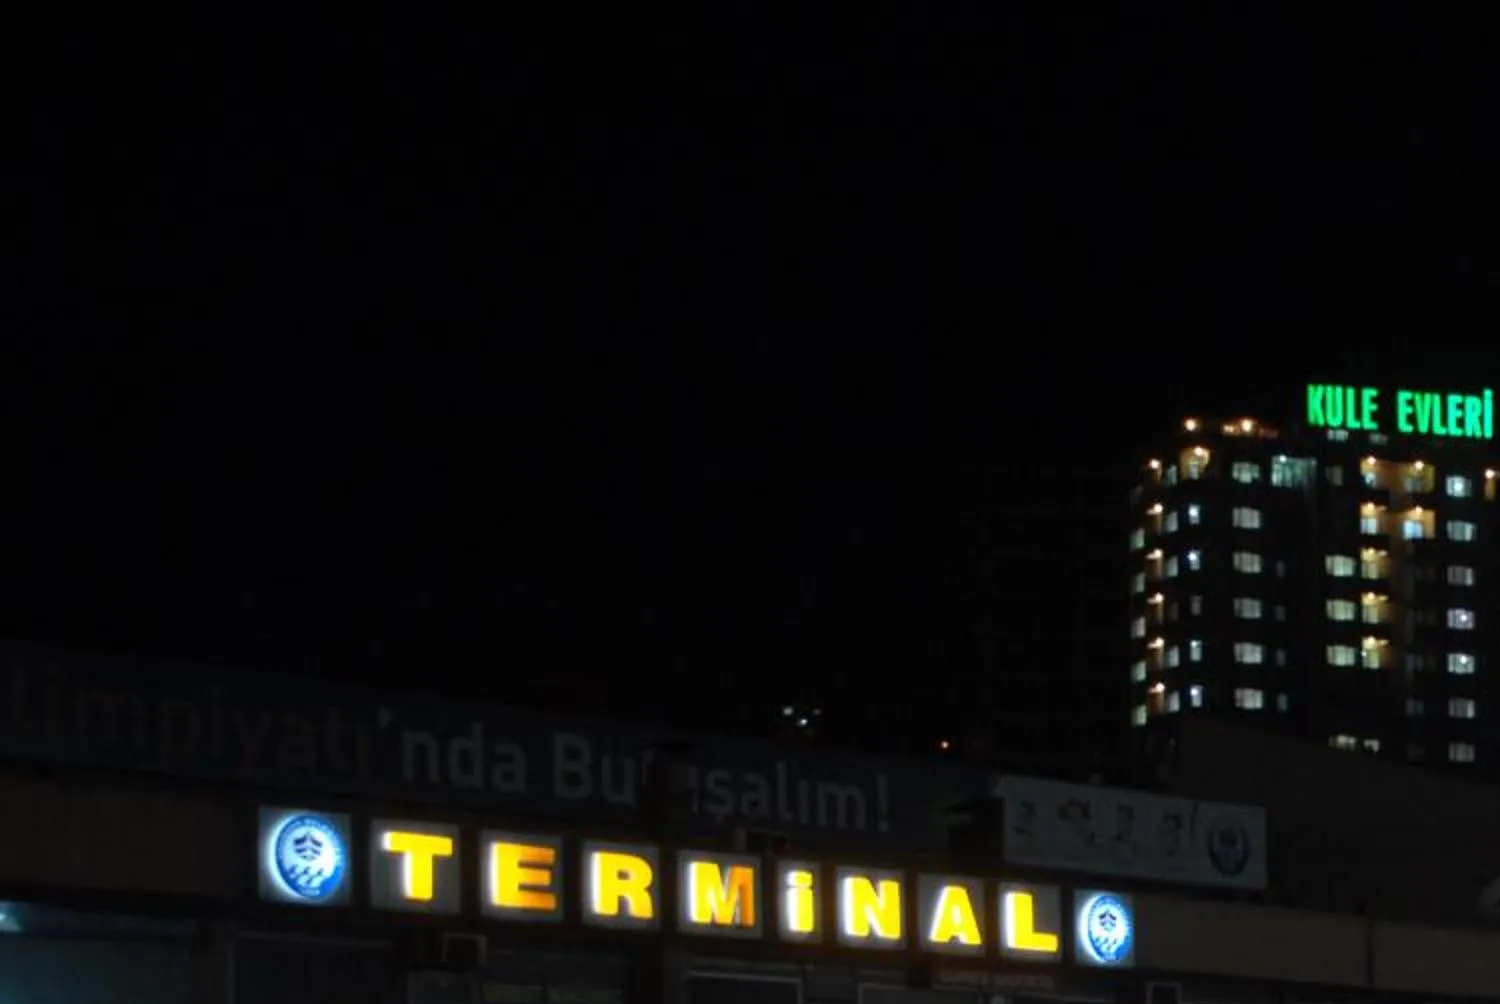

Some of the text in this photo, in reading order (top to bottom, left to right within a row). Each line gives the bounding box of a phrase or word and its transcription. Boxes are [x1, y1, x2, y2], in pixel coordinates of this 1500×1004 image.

[1307, 384, 1493, 439] KULE EVLERİ
[552, 732, 891, 833] Buşalım!
